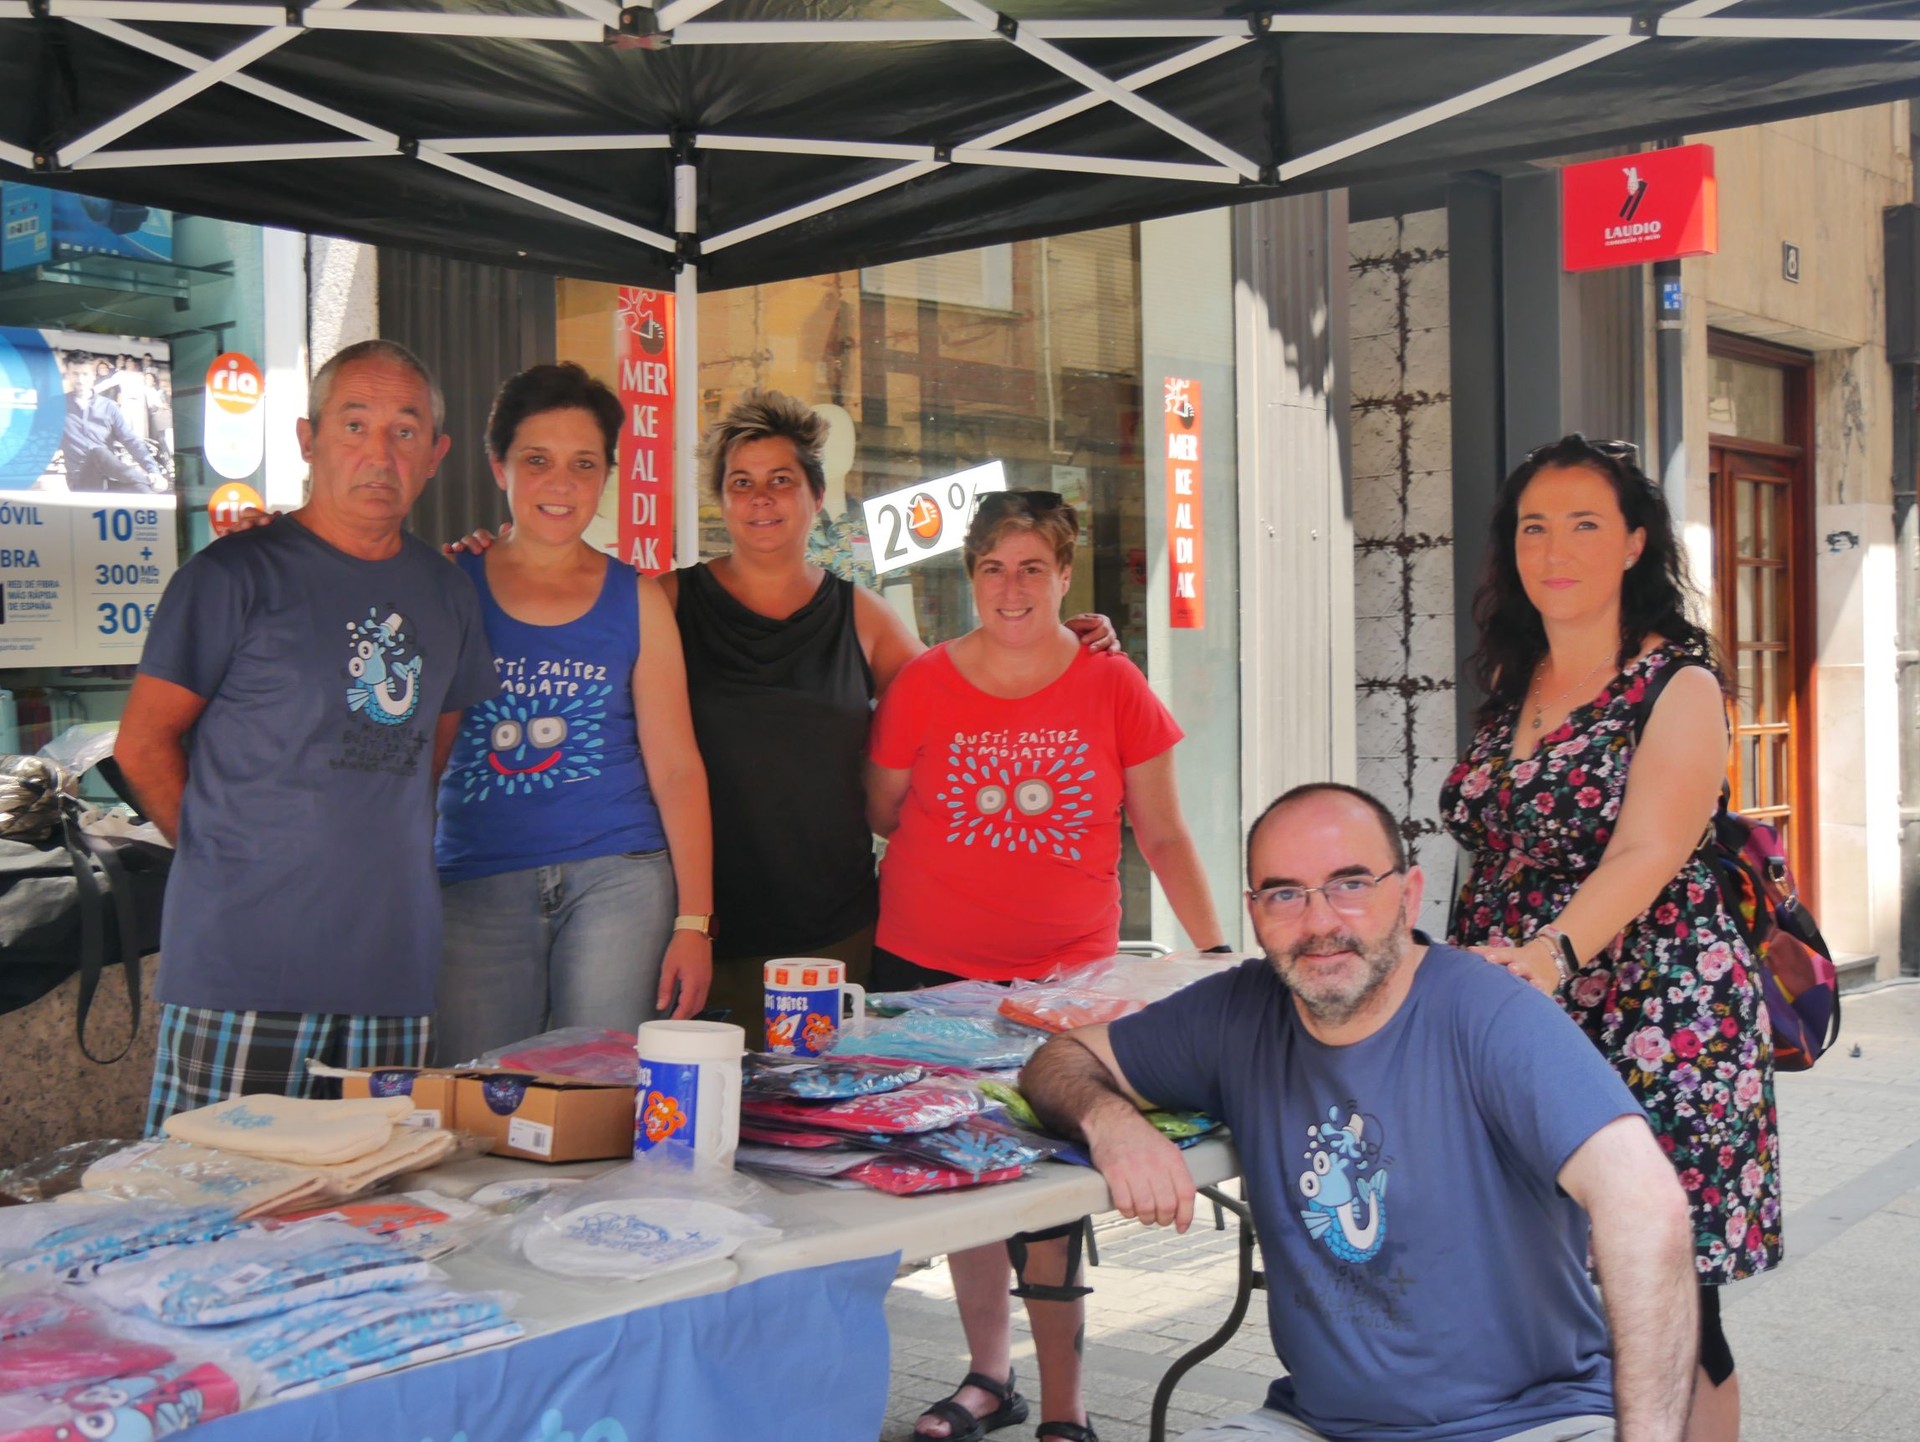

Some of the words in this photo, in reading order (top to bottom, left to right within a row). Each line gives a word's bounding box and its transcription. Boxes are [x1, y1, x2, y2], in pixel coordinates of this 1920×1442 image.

[1604, 220, 1661, 240] LAUDIO
[213, 359, 258, 395] ria
[622, 359, 669, 396] MER
[632, 404, 659, 438] KE
[1168, 433, 1198, 461] MER
[631, 448, 659, 483] AL
[1175, 468, 1193, 495] KE
[632, 492, 657, 526] DI
[1175, 503, 1194, 530] AL
[92, 508, 133, 541] 10
[134, 510, 158, 524] GB
[630, 537, 661, 570] AK
[1176, 538, 1193, 564] DI
[95, 564, 139, 585] 300
[1176, 572, 1196, 598] AK
